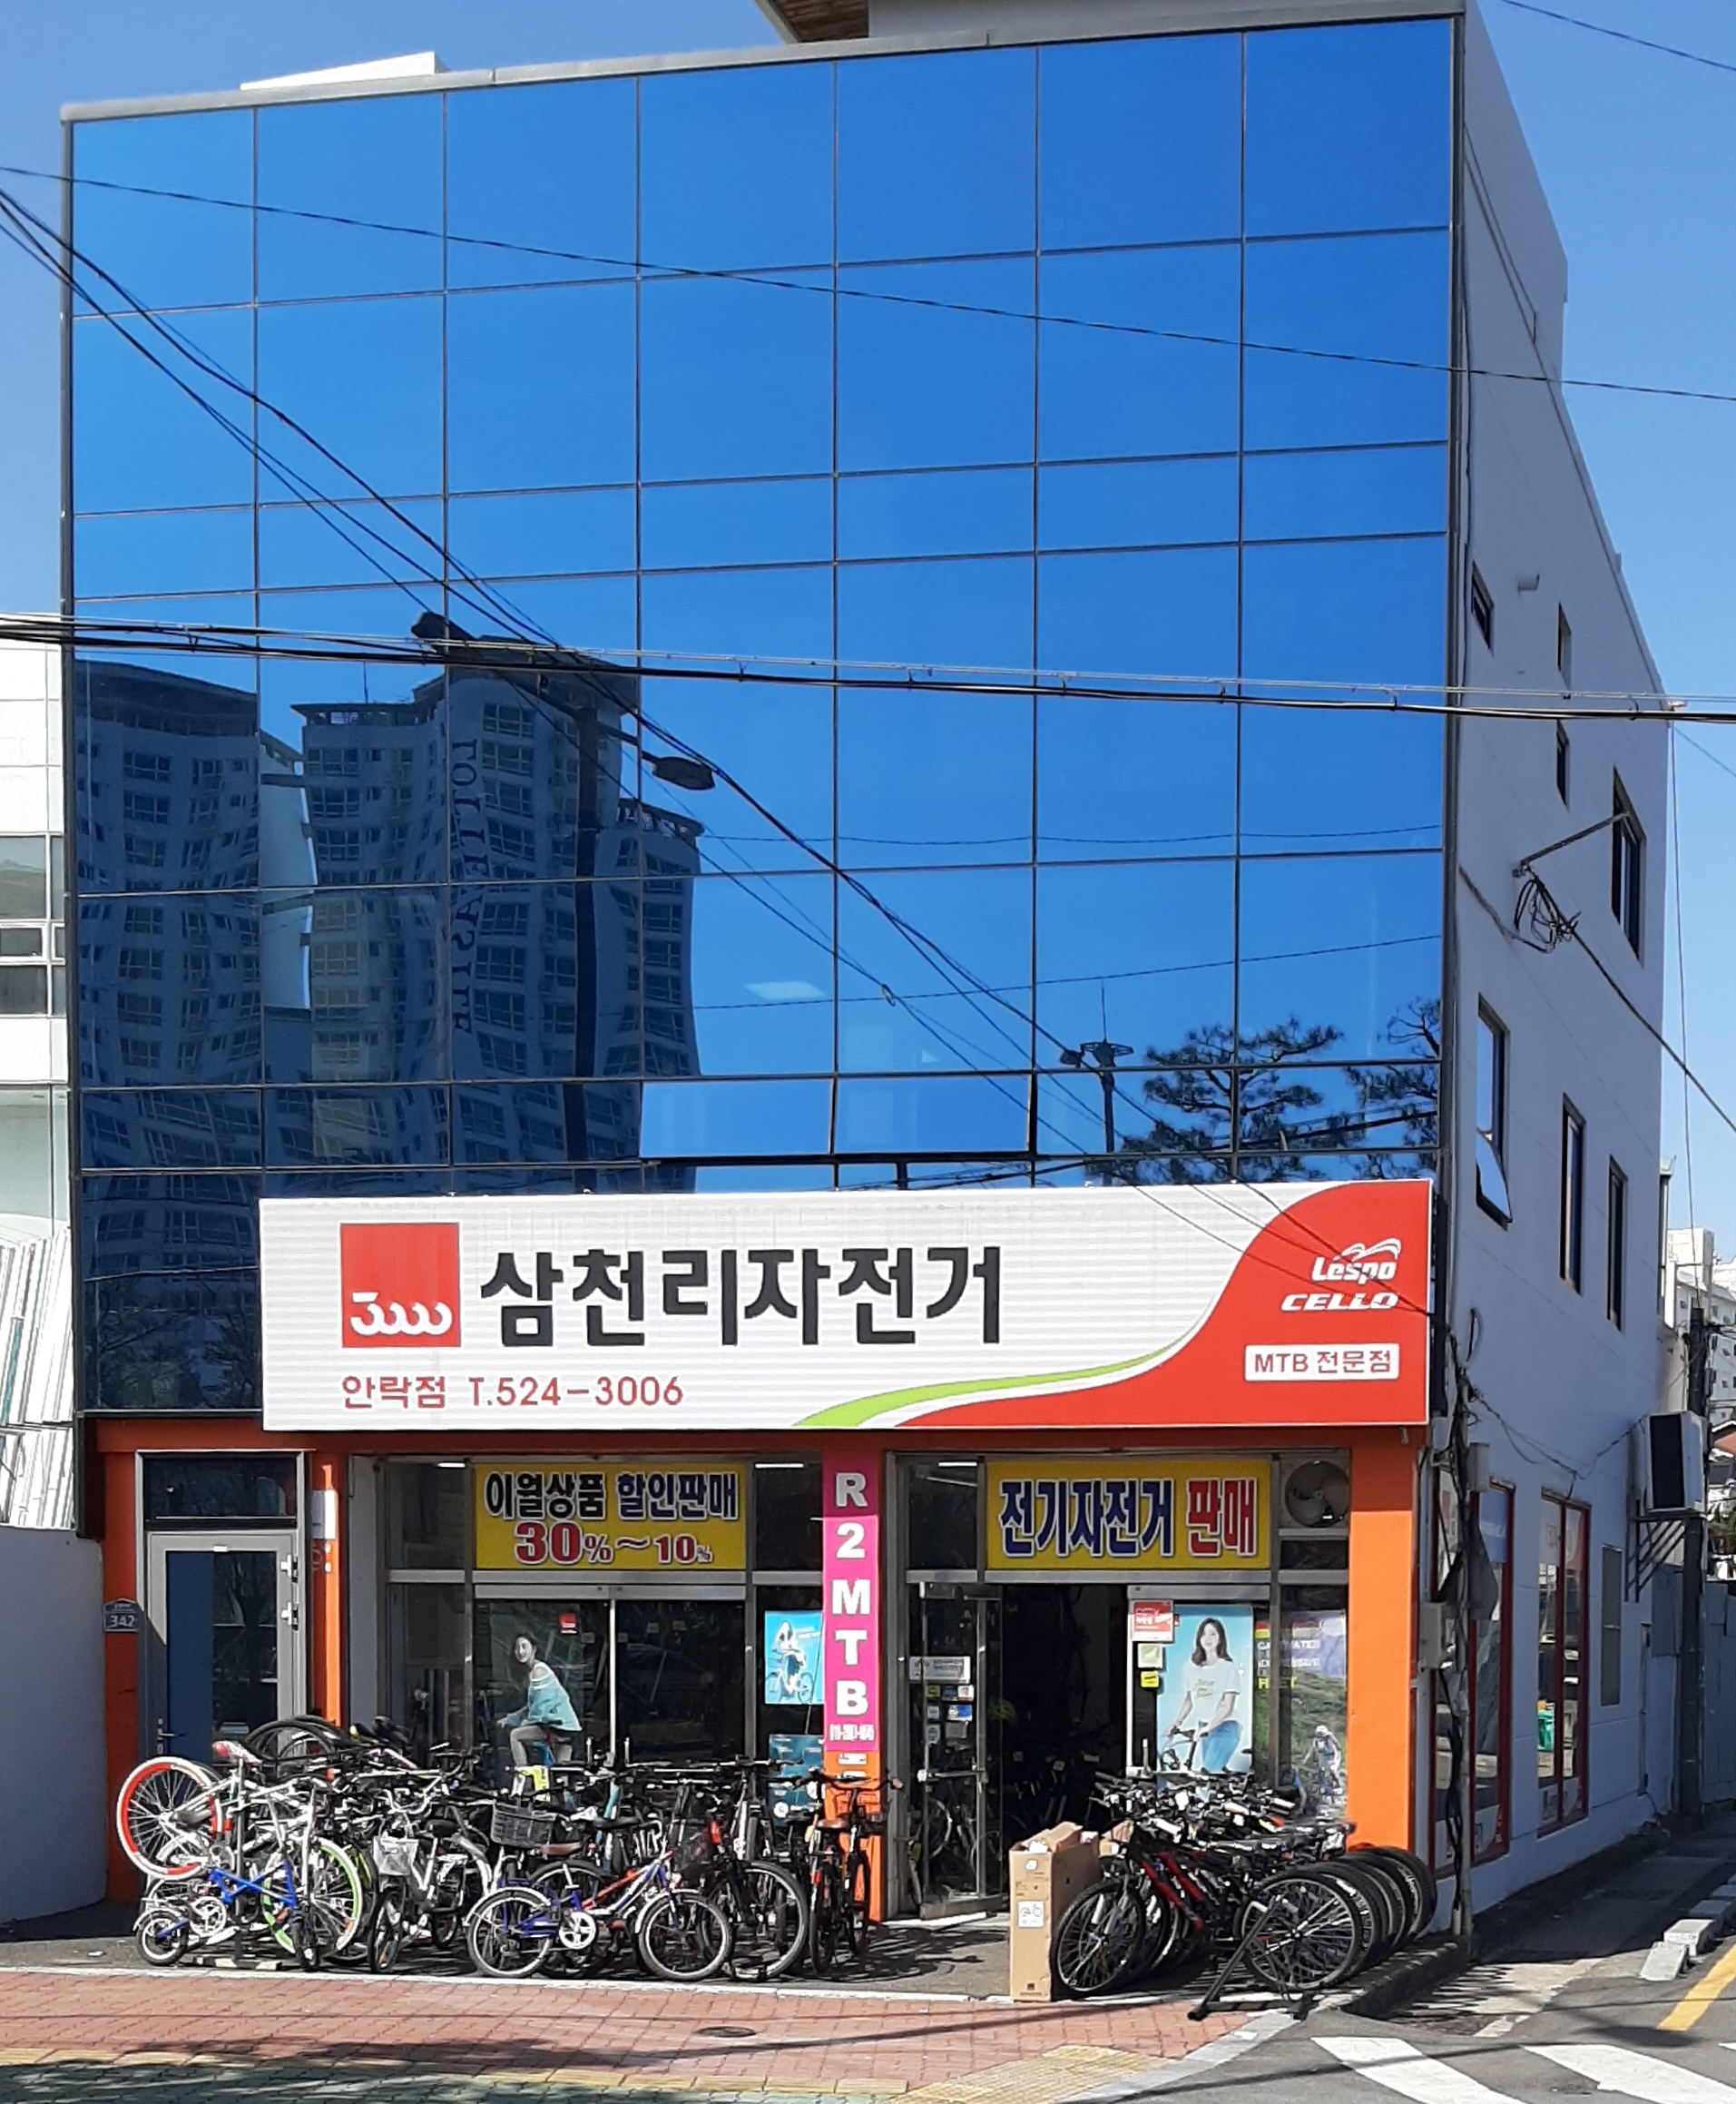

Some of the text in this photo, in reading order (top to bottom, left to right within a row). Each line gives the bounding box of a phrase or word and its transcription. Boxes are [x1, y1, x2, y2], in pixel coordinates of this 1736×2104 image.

[481, 1246, 1000, 1346] 삼천리자전거
[1280, 1293, 1399, 1312] CELLO
[1254, 1350, 1391, 1374] MTB 전문점
[342, 1375, 684, 1410] 안락점 T.524-3006
[616, 1472, 739, 1520] 할인판매
[999, 1478, 1258, 1558] 전기자전거 판매
